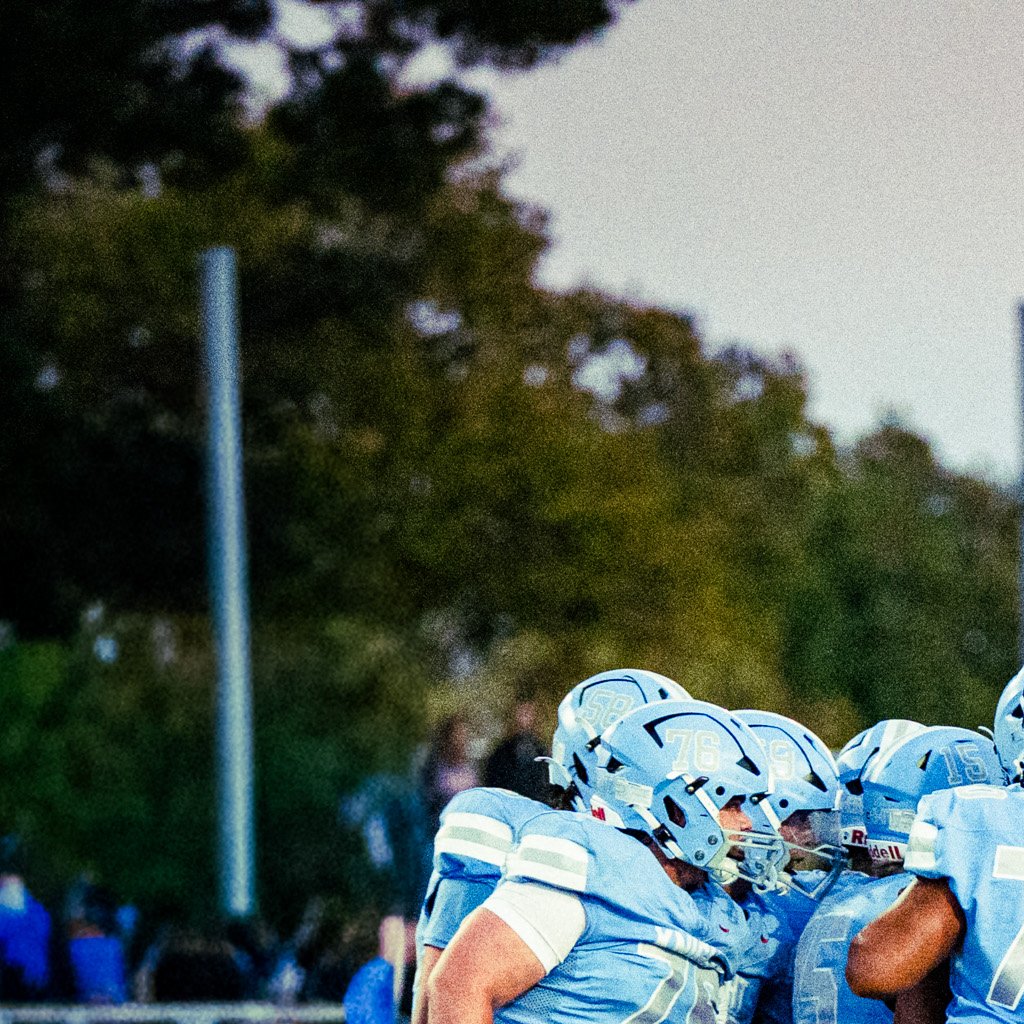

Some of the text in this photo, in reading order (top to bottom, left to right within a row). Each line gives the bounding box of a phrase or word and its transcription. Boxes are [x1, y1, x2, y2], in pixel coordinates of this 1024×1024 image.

[664, 728, 720, 773] 76
[762, 738, 796, 781] 9
[939, 743, 989, 786] 15
